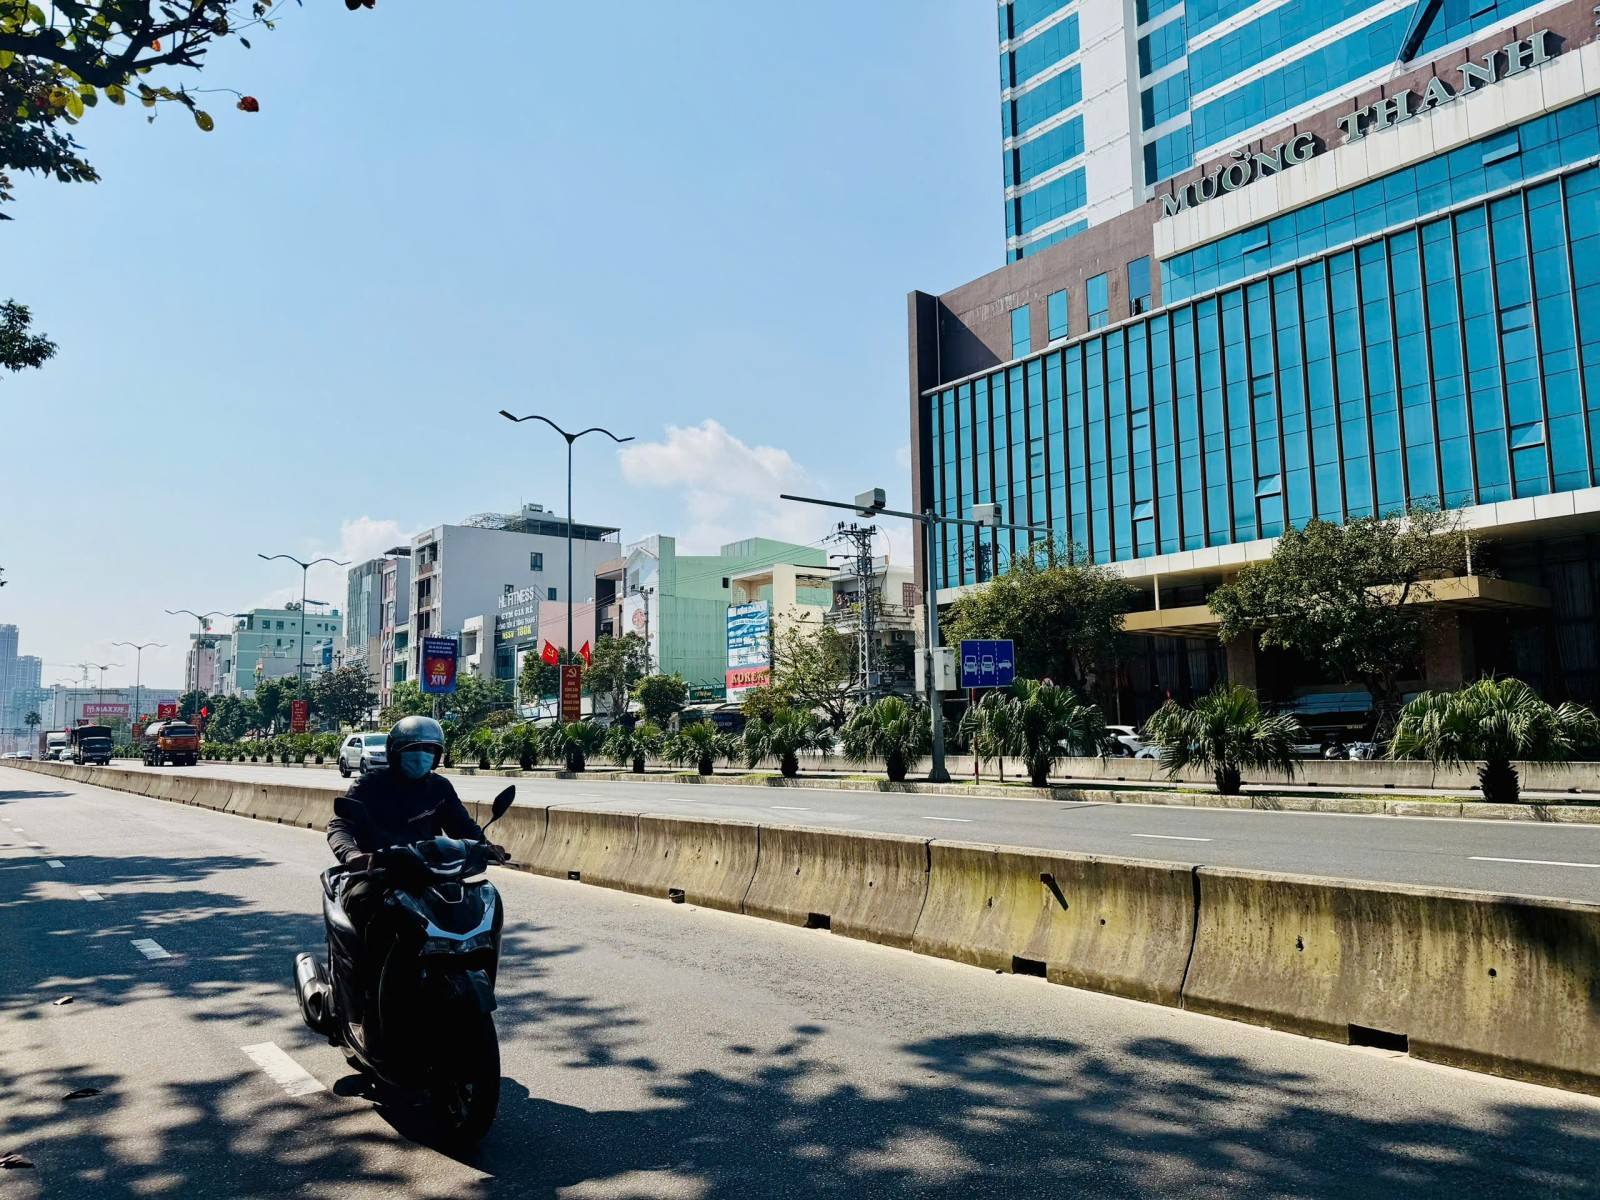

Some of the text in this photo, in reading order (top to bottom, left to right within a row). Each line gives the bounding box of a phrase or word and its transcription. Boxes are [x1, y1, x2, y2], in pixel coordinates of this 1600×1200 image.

[1160, 28, 1550, 220] MƯỜNG THANH
[507, 586, 535, 607] FITNESS
[501, 610, 514, 620] GYM
[430, 674, 447, 686] XIV
